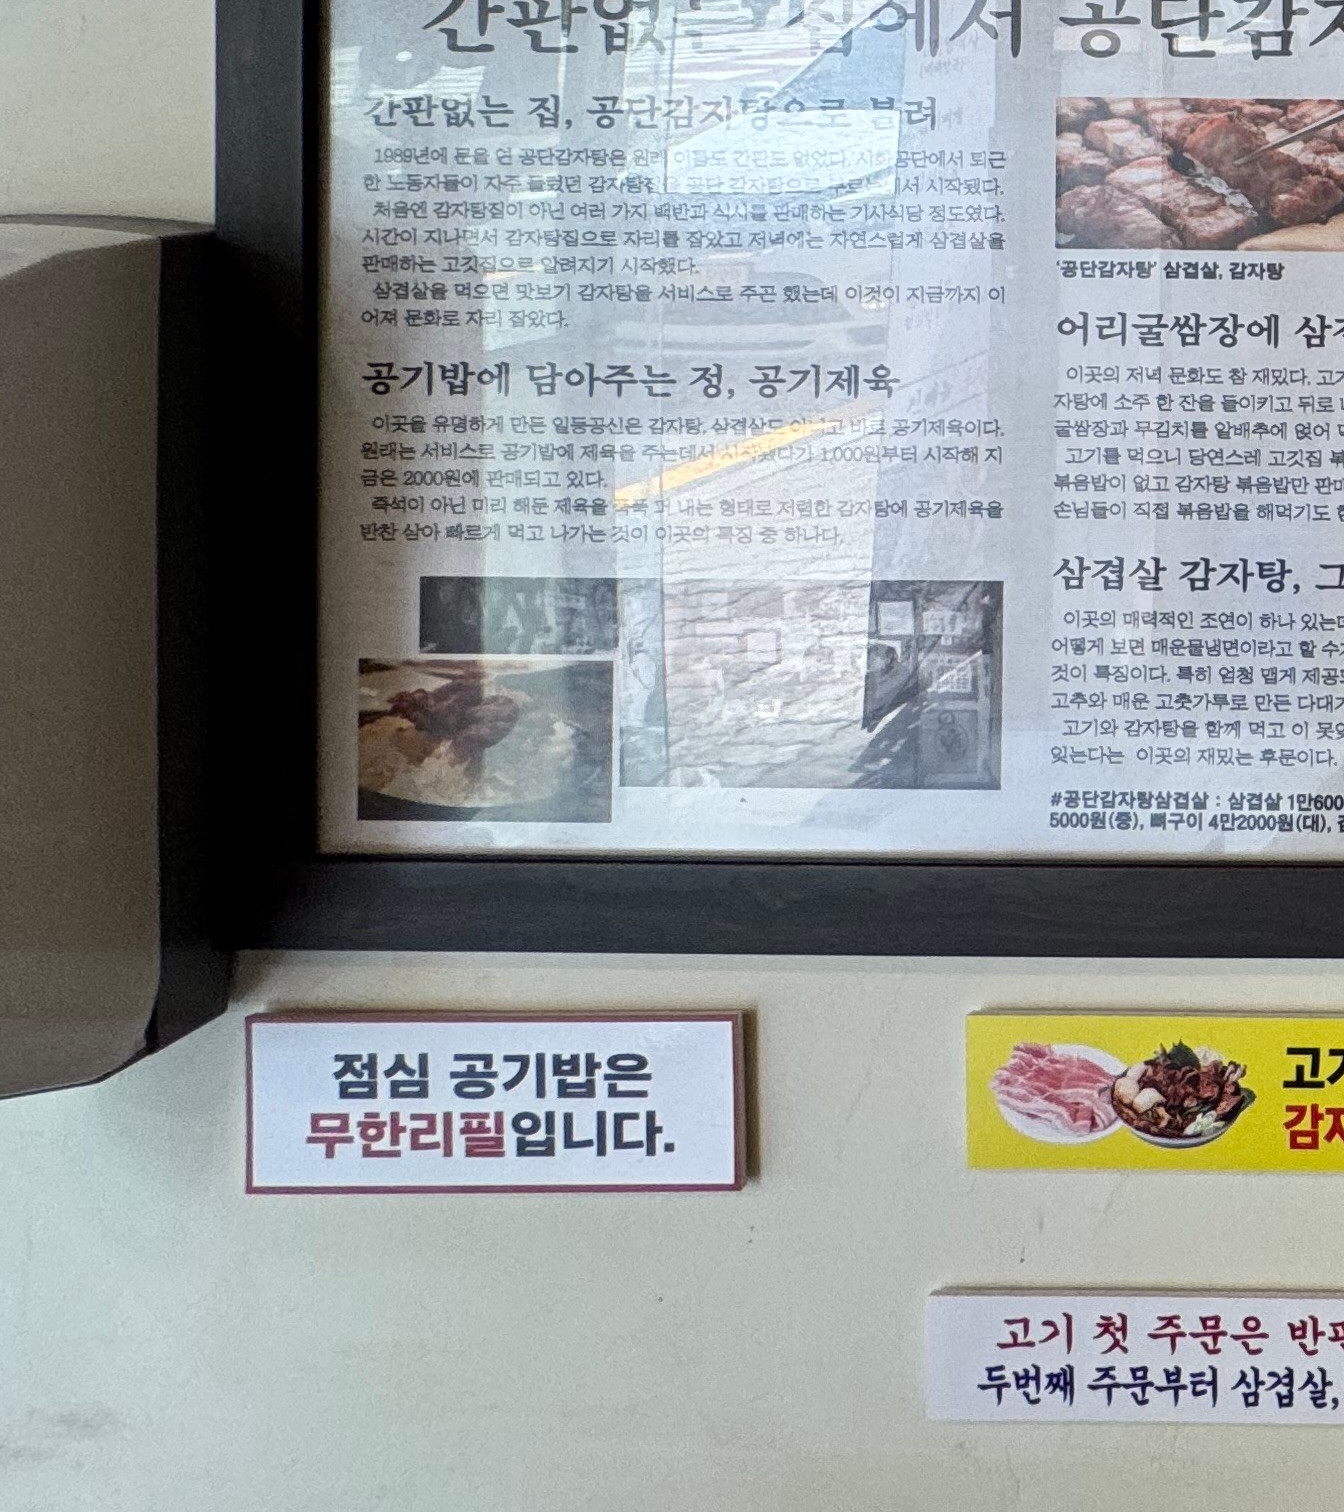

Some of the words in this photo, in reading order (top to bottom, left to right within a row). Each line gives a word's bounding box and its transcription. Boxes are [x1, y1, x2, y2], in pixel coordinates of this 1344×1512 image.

[363, 91, 515, 129] 간판없는
[527, 93, 573, 130] 집,
[585, 90, 850, 132] 공단감자탕으로
[361, 253, 438, 274] 판매하는
[440, 253, 535, 275] 고깃집으로
[540, 254, 614, 276] 알려지기
[620, 255, 701, 276] 시작했다.
[1162, 260, 1223, 280] 삼겹살,
[1228, 261, 1286, 282] 감자탕
[1057, 311, 1280, 349] 어리굴쌈장에
[361, 359, 510, 398] 공기밥에
[525, 360, 678, 398] 담아주는
[689, 362, 735, 400] 정,
[748, 362, 901, 400] 공기제육
[1066, 364, 1120, 385] 이곳의
[1126, 364, 1162, 385] 저녁
[1167, 365, 1224, 385] 문화도
[1228, 366, 1248, 386] 참
[1251, 367, 1311, 387] 재밌다.
[1064, 446, 1122, 466] 고기를
[1126, 445, 1181, 466] 먹으니
[1187, 447, 1262, 467] 당연스레
[1267, 448, 1322, 469] 고깃집
[360, 467, 399, 488] 금은
[402, 468, 480, 488] 2000원에
[485, 468, 562, 489] 판매되고
[565, 469, 608, 490] 있다.
[1053, 500, 1127, 520] 손님들이
[1133, 500, 1170, 521] 직접
[1175, 501, 1251, 522] 볶음밥을
[1255, 502, 1332, 522] 해먹기도
[1053, 555, 1168, 592] 삼겹살
[1178, 556, 1301, 595] 감자탕,
[1050, 690, 1108, 710] 고추와
[1111, 691, 1151, 710] 매운
[1154, 691, 1249, 712] 고춧가루로
[1254, 692, 1292, 713] 만든
[1050, 744, 1126, 765] 잊는다는
[1136, 745, 1191, 766] 이곳의
[1196, 745, 1255, 767] 재밌는
[1258, 747, 1338, 768] 후문이다.
[1227, 790, 1283, 812] 삼겹살
[1208, 811, 1332, 834] 4만2000원(대),
[332, 1051, 429, 1100] 점심
[449, 1051, 653, 1101] 공기밥은
[305, 1109, 675, 1159] 무한리필입니다.
[996, 1311, 1073, 1355] 고기
[1092, 1311, 1129, 1355] 첫
[1147, 1313, 1270, 1356] 주문은
[977, 1362, 1075, 1407] 두번째
[1086, 1364, 1218, 1408] 주문부터
[1230, 1365, 1339, 1410] 삼겹살,
